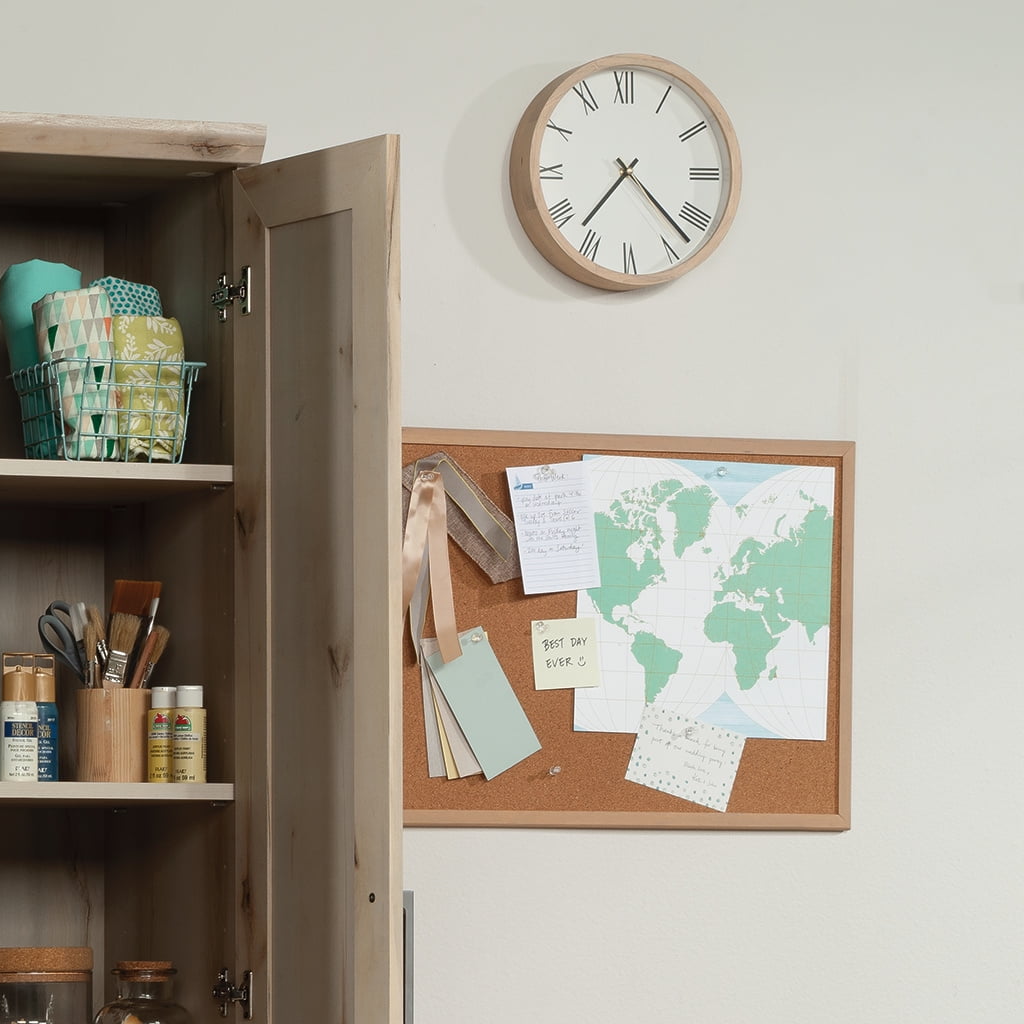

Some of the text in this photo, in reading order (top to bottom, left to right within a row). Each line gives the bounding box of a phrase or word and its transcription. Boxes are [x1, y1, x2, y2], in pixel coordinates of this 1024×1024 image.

[613, 71, 635, 104] XII
[572, 80, 599, 116] XI
[678, 120, 707, 142] II
[688, 167, 720, 181] III
[541, 636, 587, 652] BEST DAY
[545, 657, 573, 669] EVER
